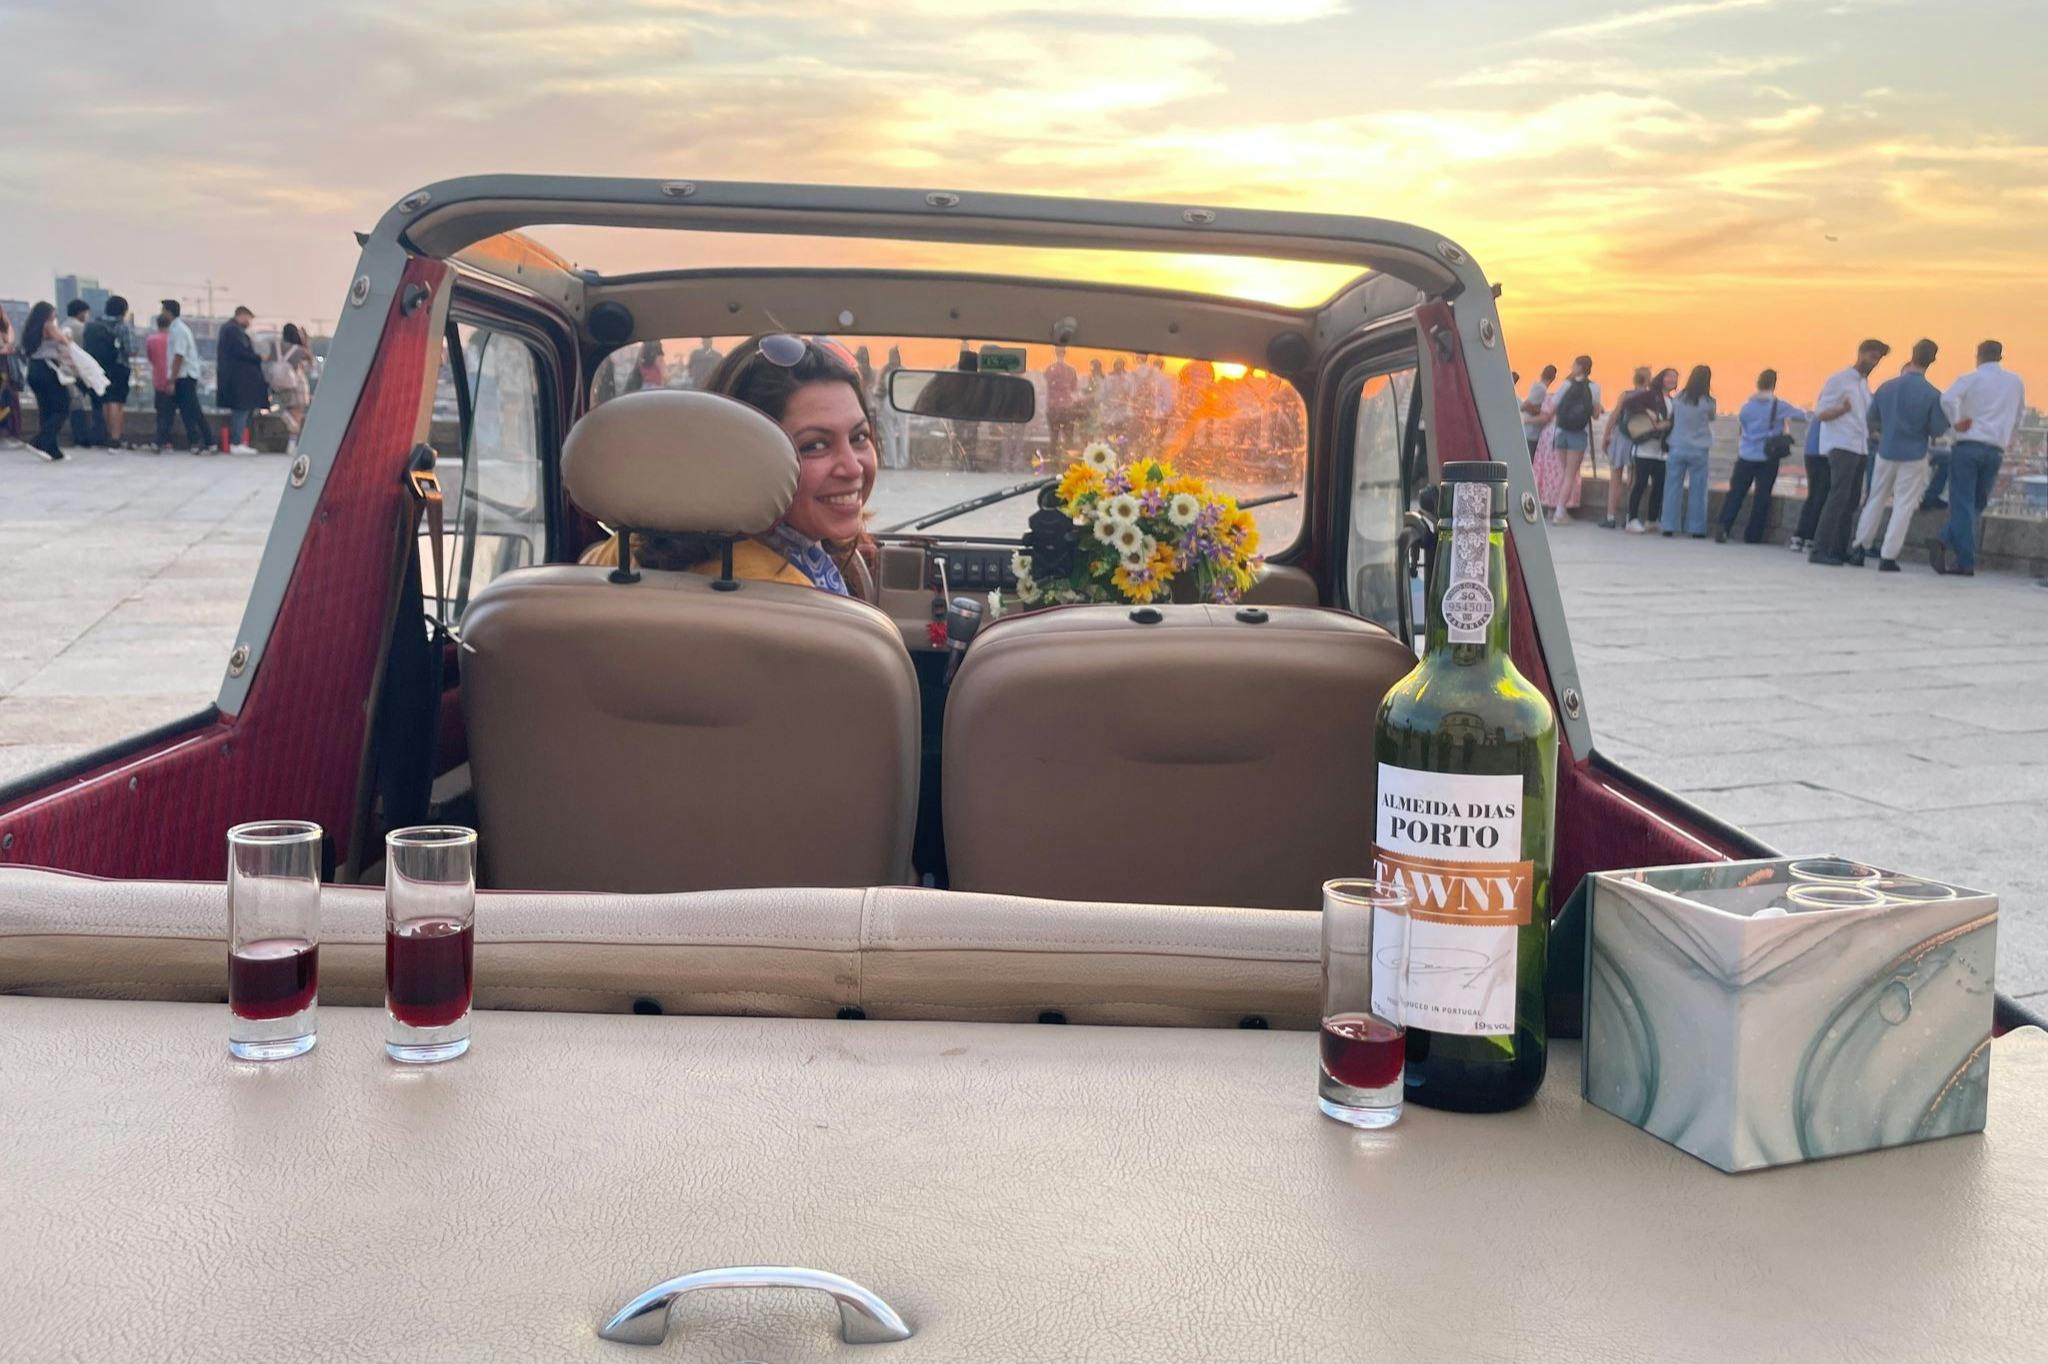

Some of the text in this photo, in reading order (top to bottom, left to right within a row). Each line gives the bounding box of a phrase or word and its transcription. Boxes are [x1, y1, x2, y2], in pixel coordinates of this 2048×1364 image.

[1382, 792, 1515, 819] ALMEIDA DIAS
[1390, 816, 1499, 849] PORTO
[1373, 859, 1525, 911] TAWNY
[1431, 1005, 1440, 1013] IN
[1442, 1006, 1481, 1017] PORTUGAL
